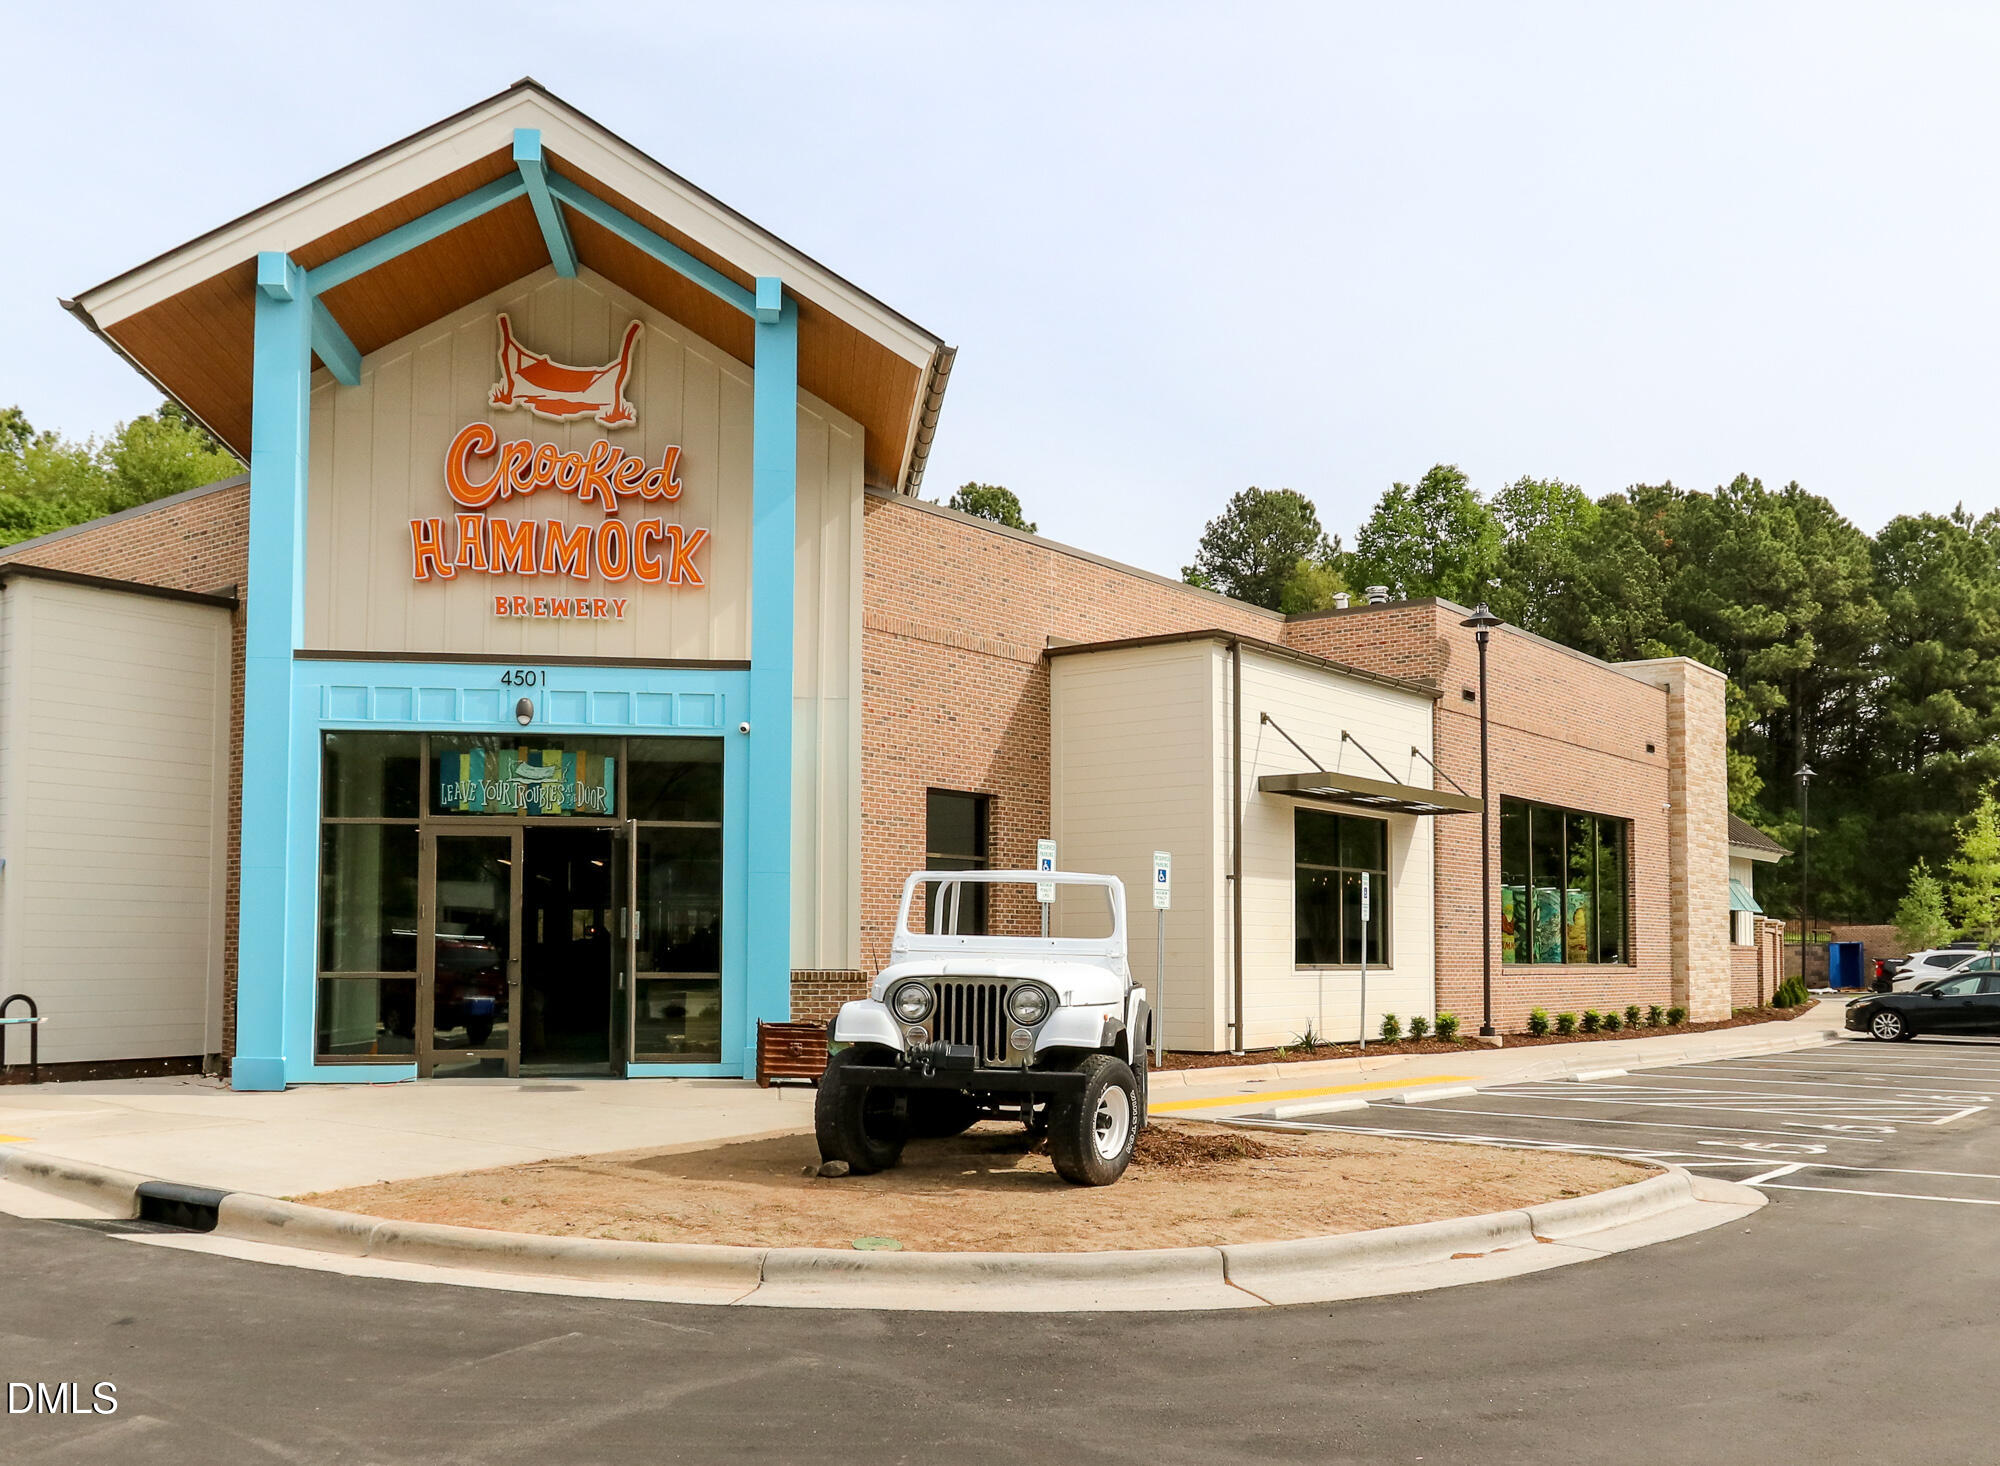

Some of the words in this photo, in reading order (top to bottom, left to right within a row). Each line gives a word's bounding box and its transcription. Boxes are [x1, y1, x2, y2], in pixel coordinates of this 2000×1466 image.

[409, 513, 711, 587] HAMMOCK
[494, 594, 628, 619] BREWERY
[501, 670, 546, 687] 4501
[441, 779, 477, 805] LEAVE
[478, 779, 512, 806] YOUR
[512, 782, 566, 811] TROUBLES
[577, 781, 608, 812] DOOR
